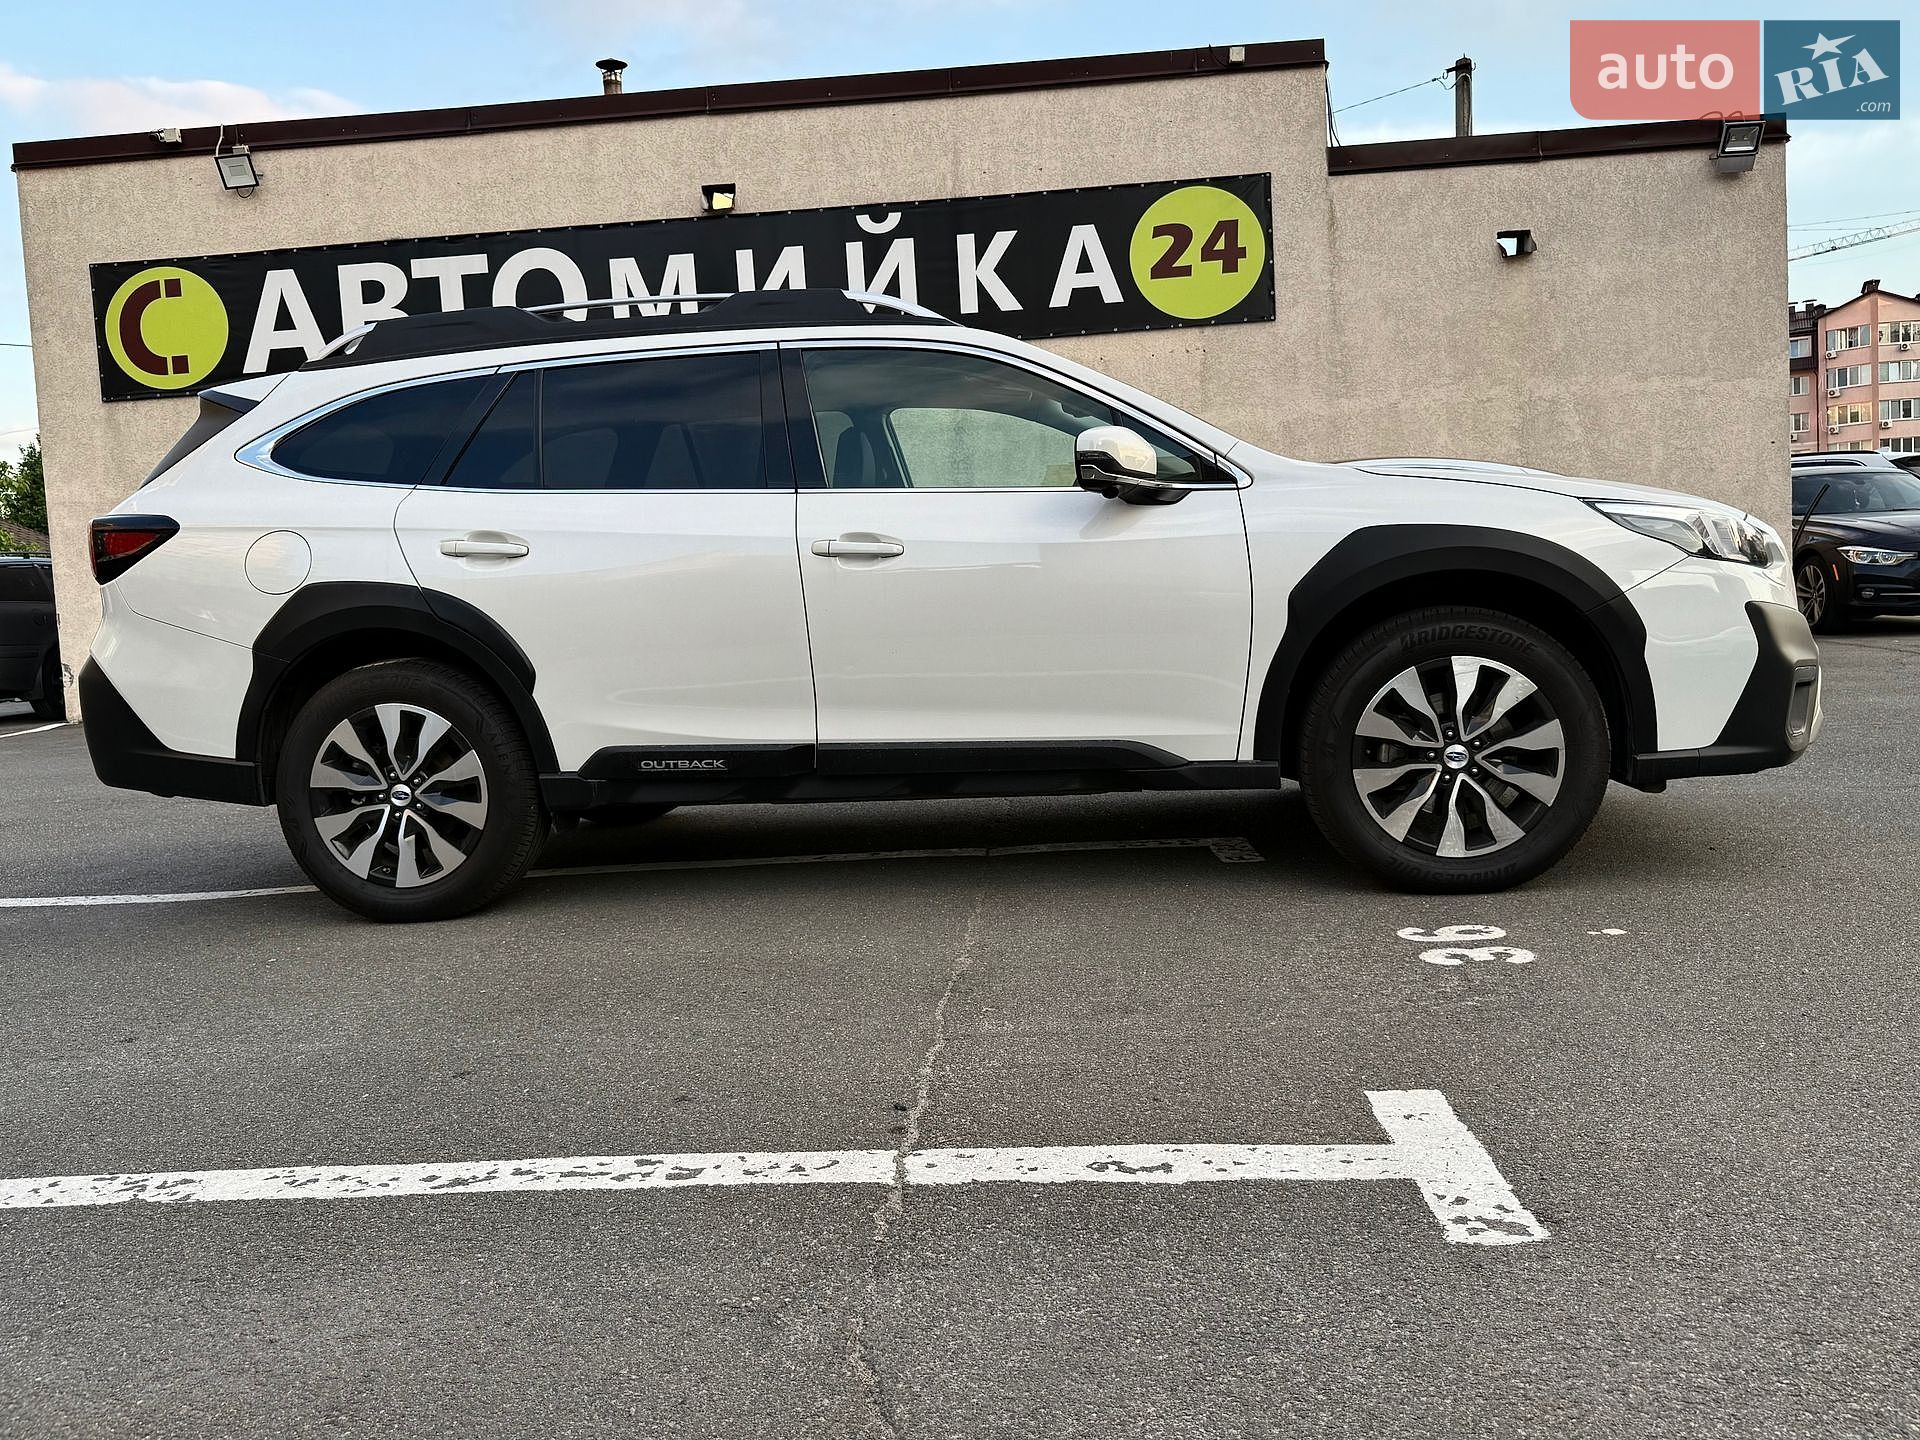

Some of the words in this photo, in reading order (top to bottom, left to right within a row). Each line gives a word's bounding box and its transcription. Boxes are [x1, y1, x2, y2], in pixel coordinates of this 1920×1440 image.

[242, 211, 1125, 374] АВТОМИЙКА
[1149, 219, 1248, 281] 24
[640, 759, 726, 769] OUTBACK
